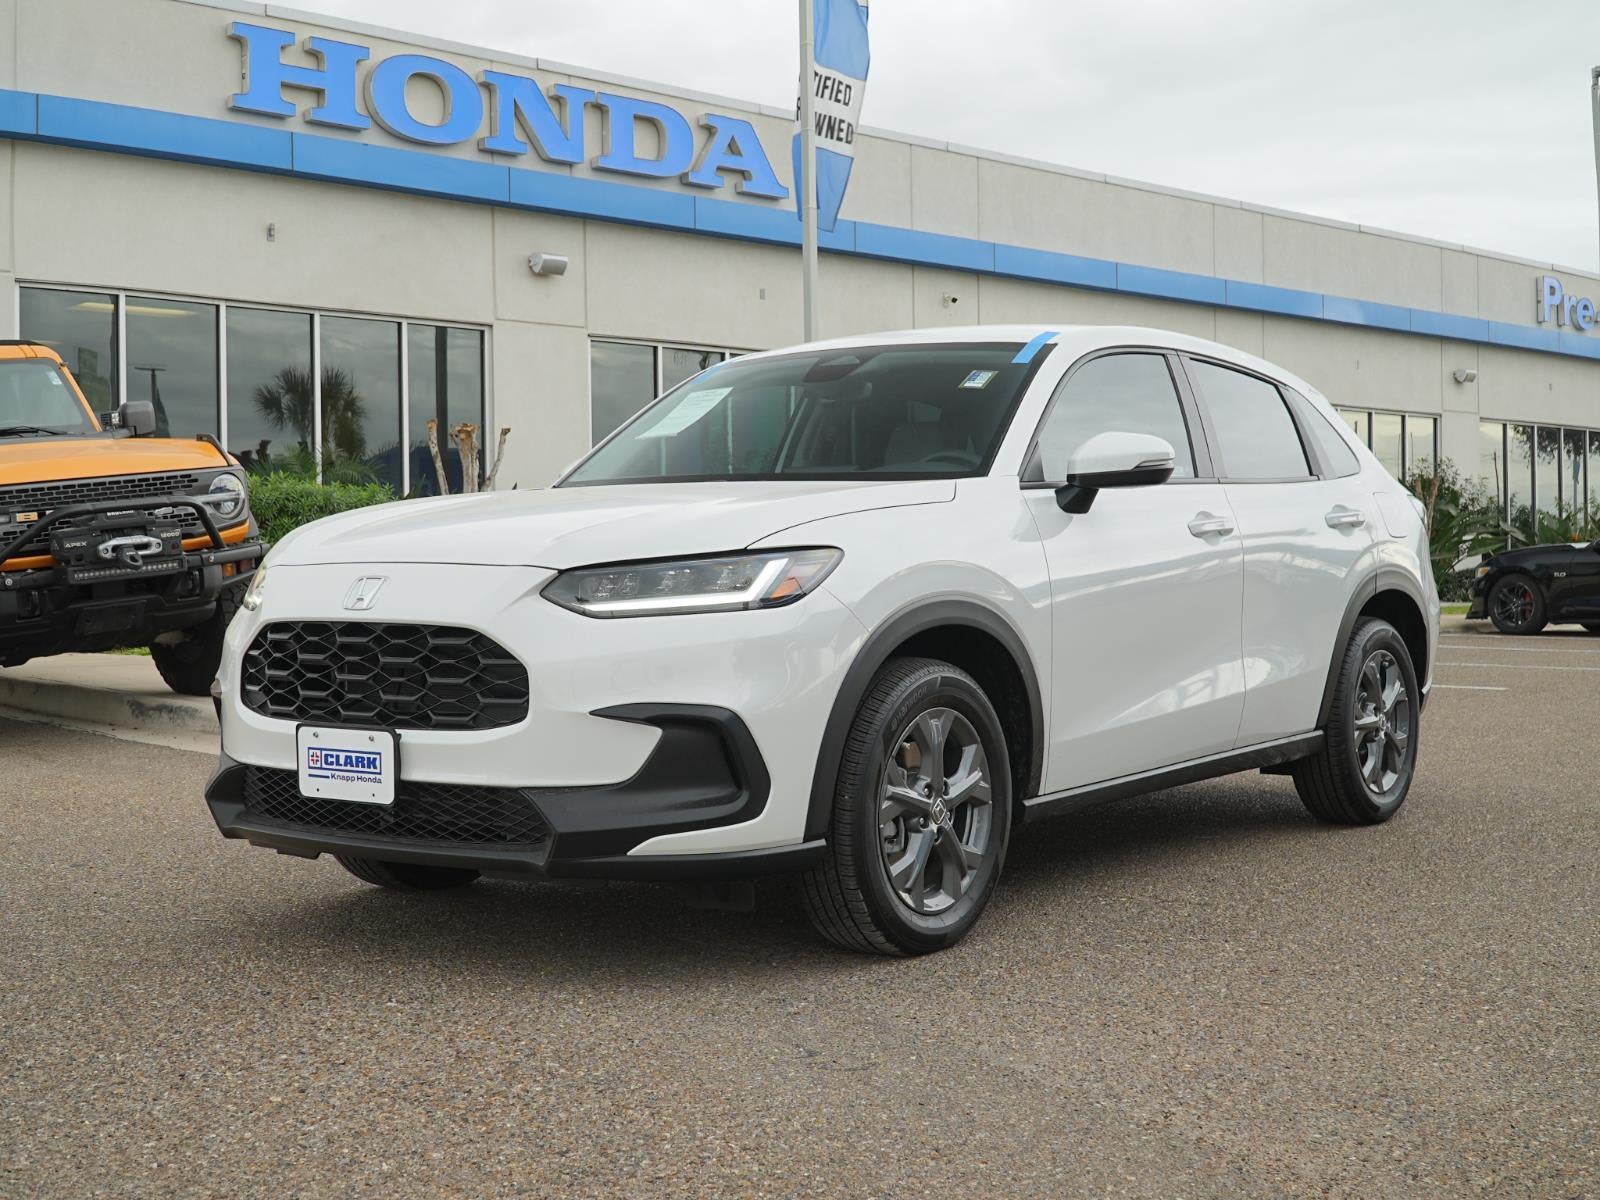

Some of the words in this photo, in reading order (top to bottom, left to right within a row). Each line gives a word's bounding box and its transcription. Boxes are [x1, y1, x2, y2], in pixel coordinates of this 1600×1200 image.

[227, 21, 789, 199] HONDA
[65, 540, 87, 548] APEX
[323, 753, 378, 770] CLARK
[330, 773, 355, 783] Knapp
[357, 775, 382, 784] Honda
